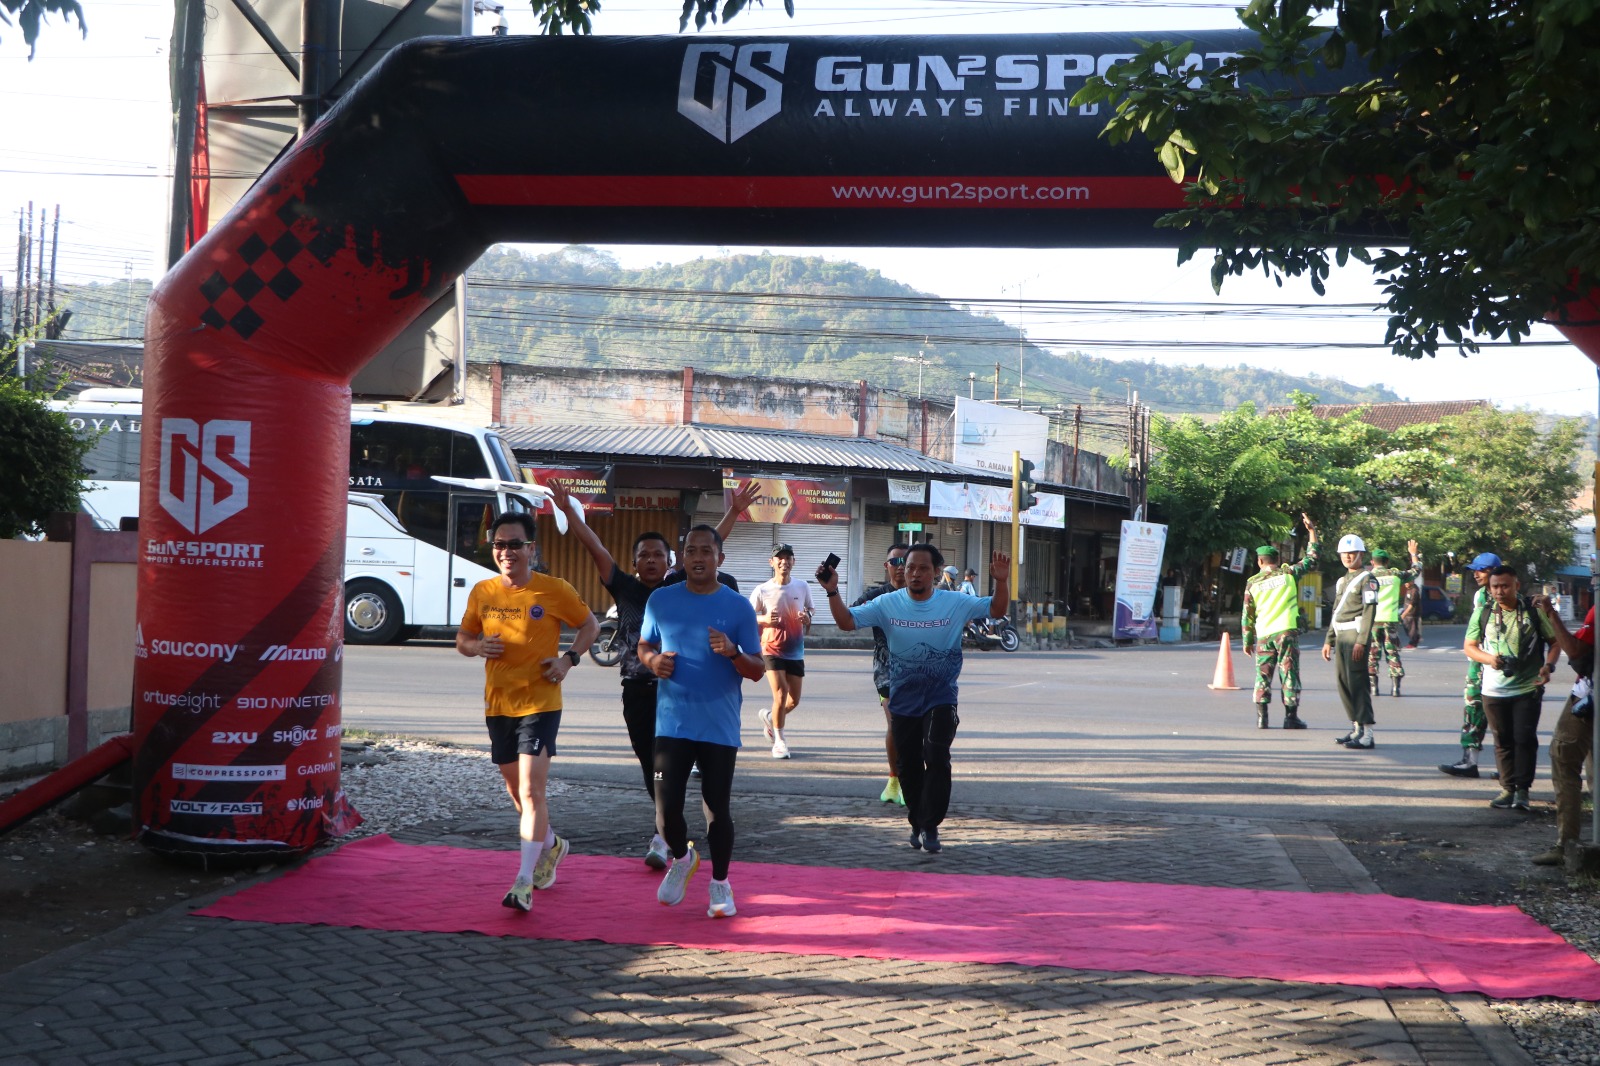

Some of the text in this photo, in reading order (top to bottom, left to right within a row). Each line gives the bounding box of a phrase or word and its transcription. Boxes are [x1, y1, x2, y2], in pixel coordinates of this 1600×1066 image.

[814, 98, 983, 118] ALWAYS
[831, 182, 1090, 204] www.gun2sport.com
[575, 478, 607, 487] RASANYA
[570, 487, 607, 495] HARGANYA
[901, 484, 921, 492] SAGA
[821, 490, 846, 498] RASANYA
[817, 497, 846, 505] HARGANYA
[180, 557, 264, 567] SUPERSTORE
[490, 605, 522, 614] Maybank
[890, 618, 951, 628] INDONESIA
[237, 698, 268, 709] 910
[212, 731, 258, 744] 2XU
[273, 729, 318, 743] SHOKZ
[190, 769, 281, 777] COMPRESSPORT
[297, 761, 336, 776] GARMIN
[170, 801, 263, 813] VOLT FAST
[298, 795, 324, 810] Kniel
